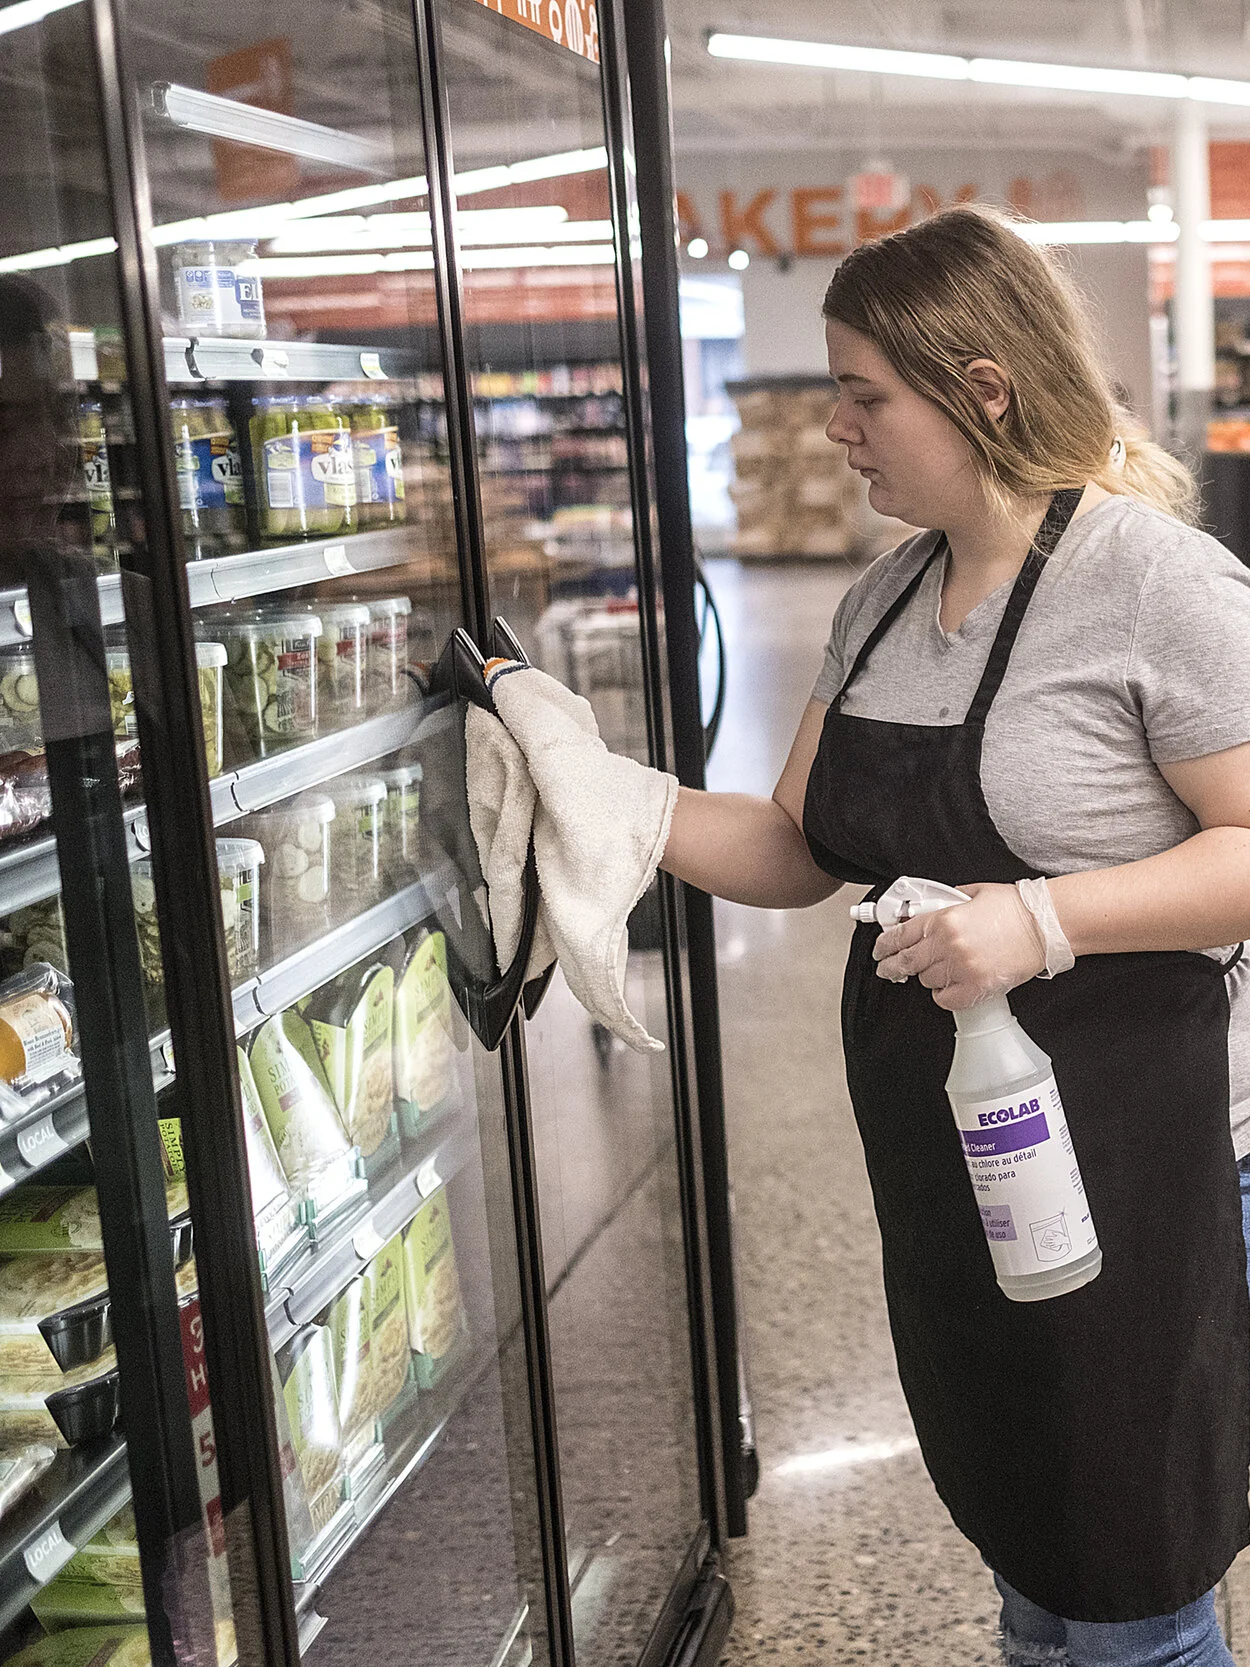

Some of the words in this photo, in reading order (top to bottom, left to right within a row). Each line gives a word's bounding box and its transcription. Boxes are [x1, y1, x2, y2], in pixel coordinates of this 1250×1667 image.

[978, 1099, 1040, 1127] ECOLAB
[22, 1126, 54, 1153] LOCAL
[165, 1122, 187, 1174] SIMPLY
[971, 1143, 996, 1152] Cleaner
[979, 1159, 1000, 1168] chlore
[1002, 1157, 1012, 1166] au
[1014, 1149, 1037, 1162] détail
[998, 1170, 1016, 1182] para
[29, 1531, 62, 1567] LOCAL
